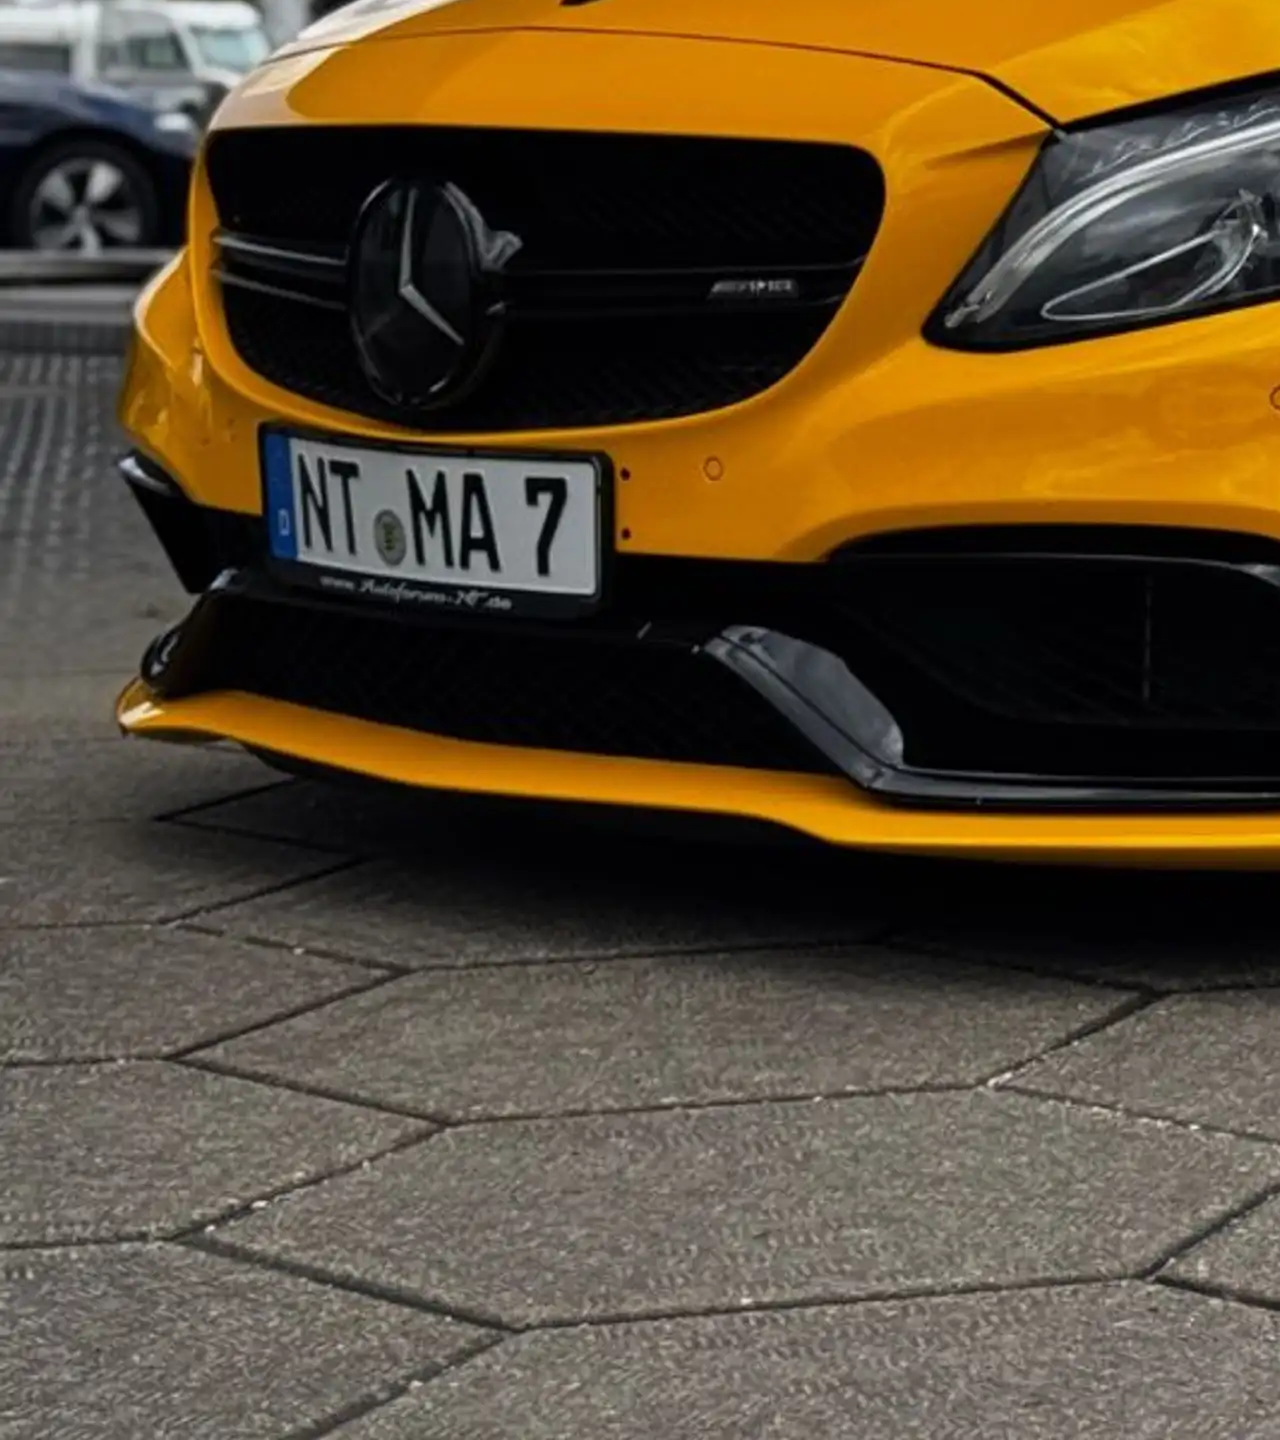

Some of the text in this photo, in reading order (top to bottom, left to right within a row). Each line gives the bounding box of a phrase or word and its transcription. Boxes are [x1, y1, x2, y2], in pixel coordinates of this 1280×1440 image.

[299, 454, 568, 576] NT MA 7
